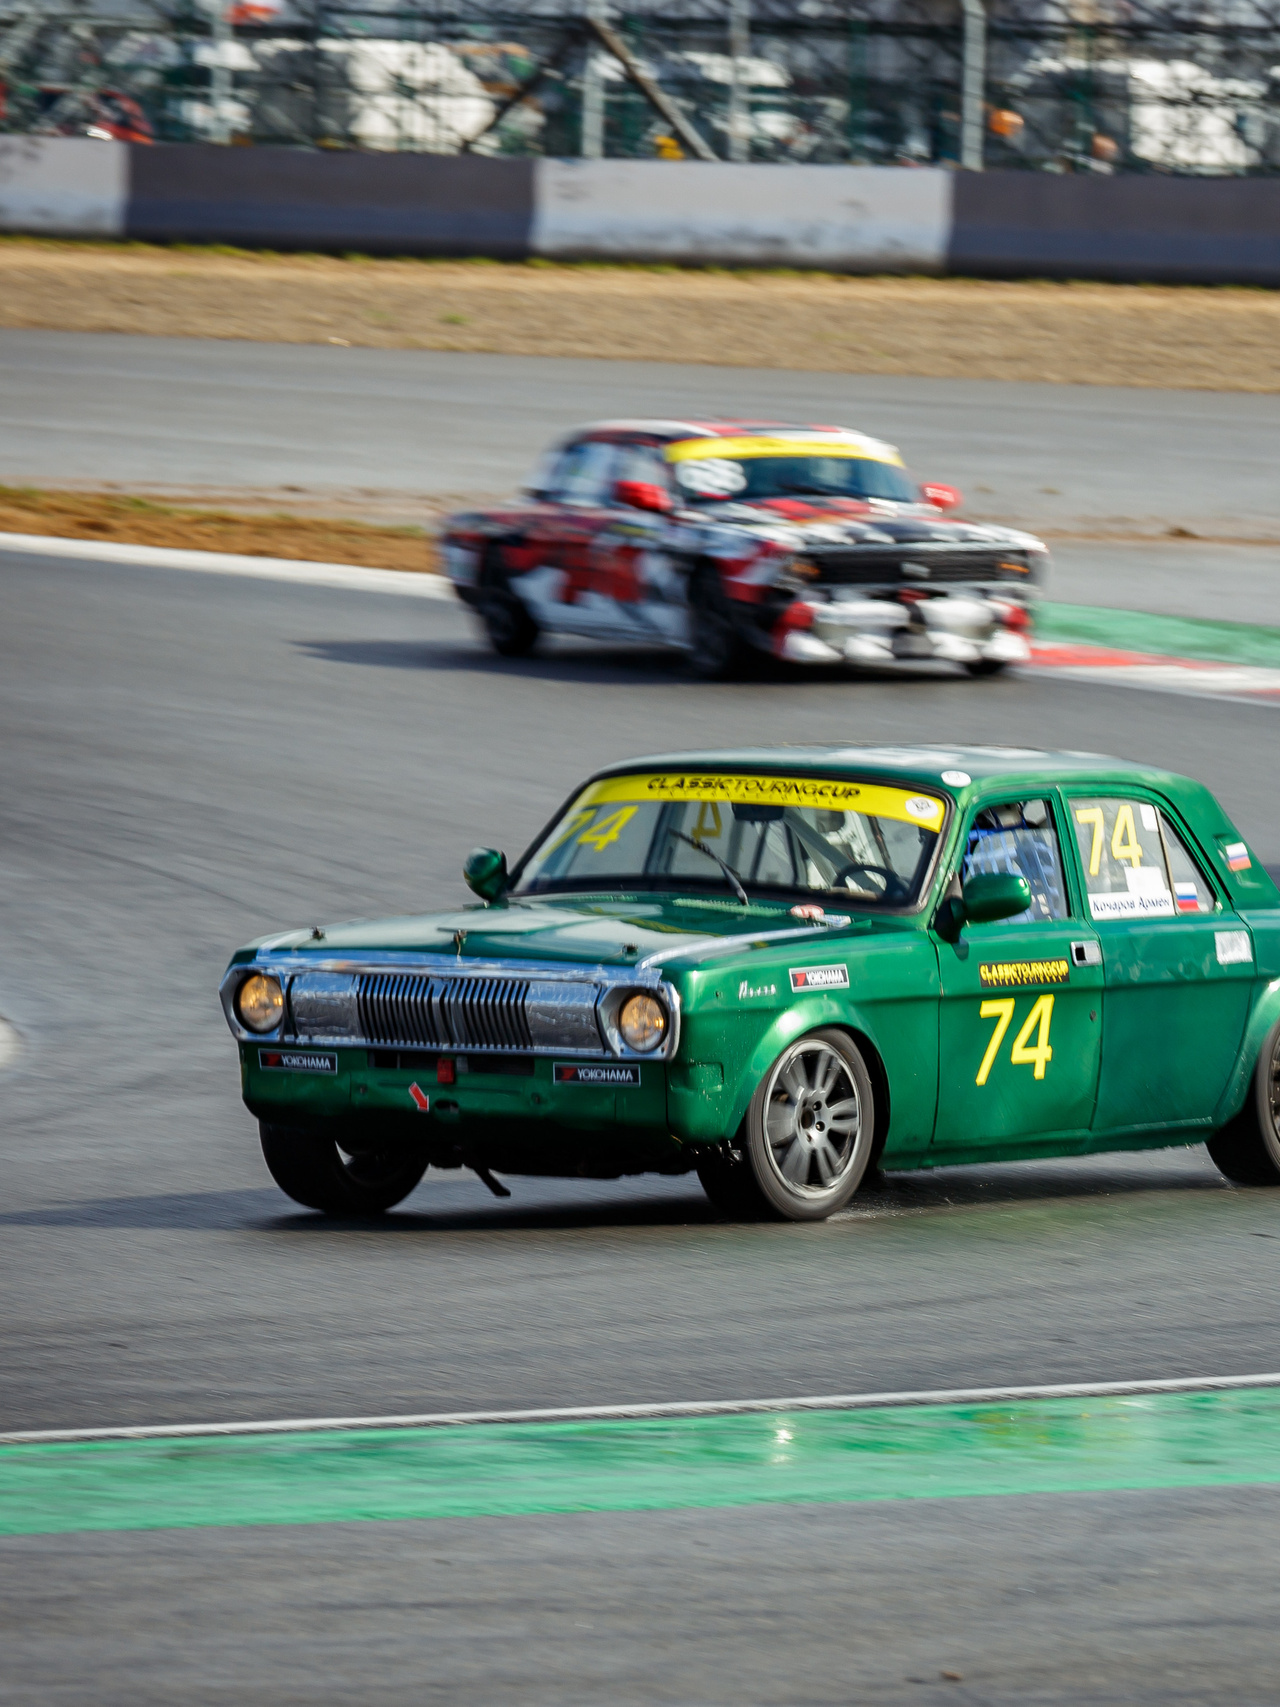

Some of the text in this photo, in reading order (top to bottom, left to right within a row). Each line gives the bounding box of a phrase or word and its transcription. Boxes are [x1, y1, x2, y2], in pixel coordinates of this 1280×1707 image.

[647, 777, 860, 800] CLASSICTOURINGCUP
[539, 804, 640, 861] 74
[1075, 804, 1143, 876] 74
[975, 994, 1055, 1087] 74
[281, 1053, 331, 1070] YOKOHAMA
[577, 1066, 634, 1083] YOKOHAMA
